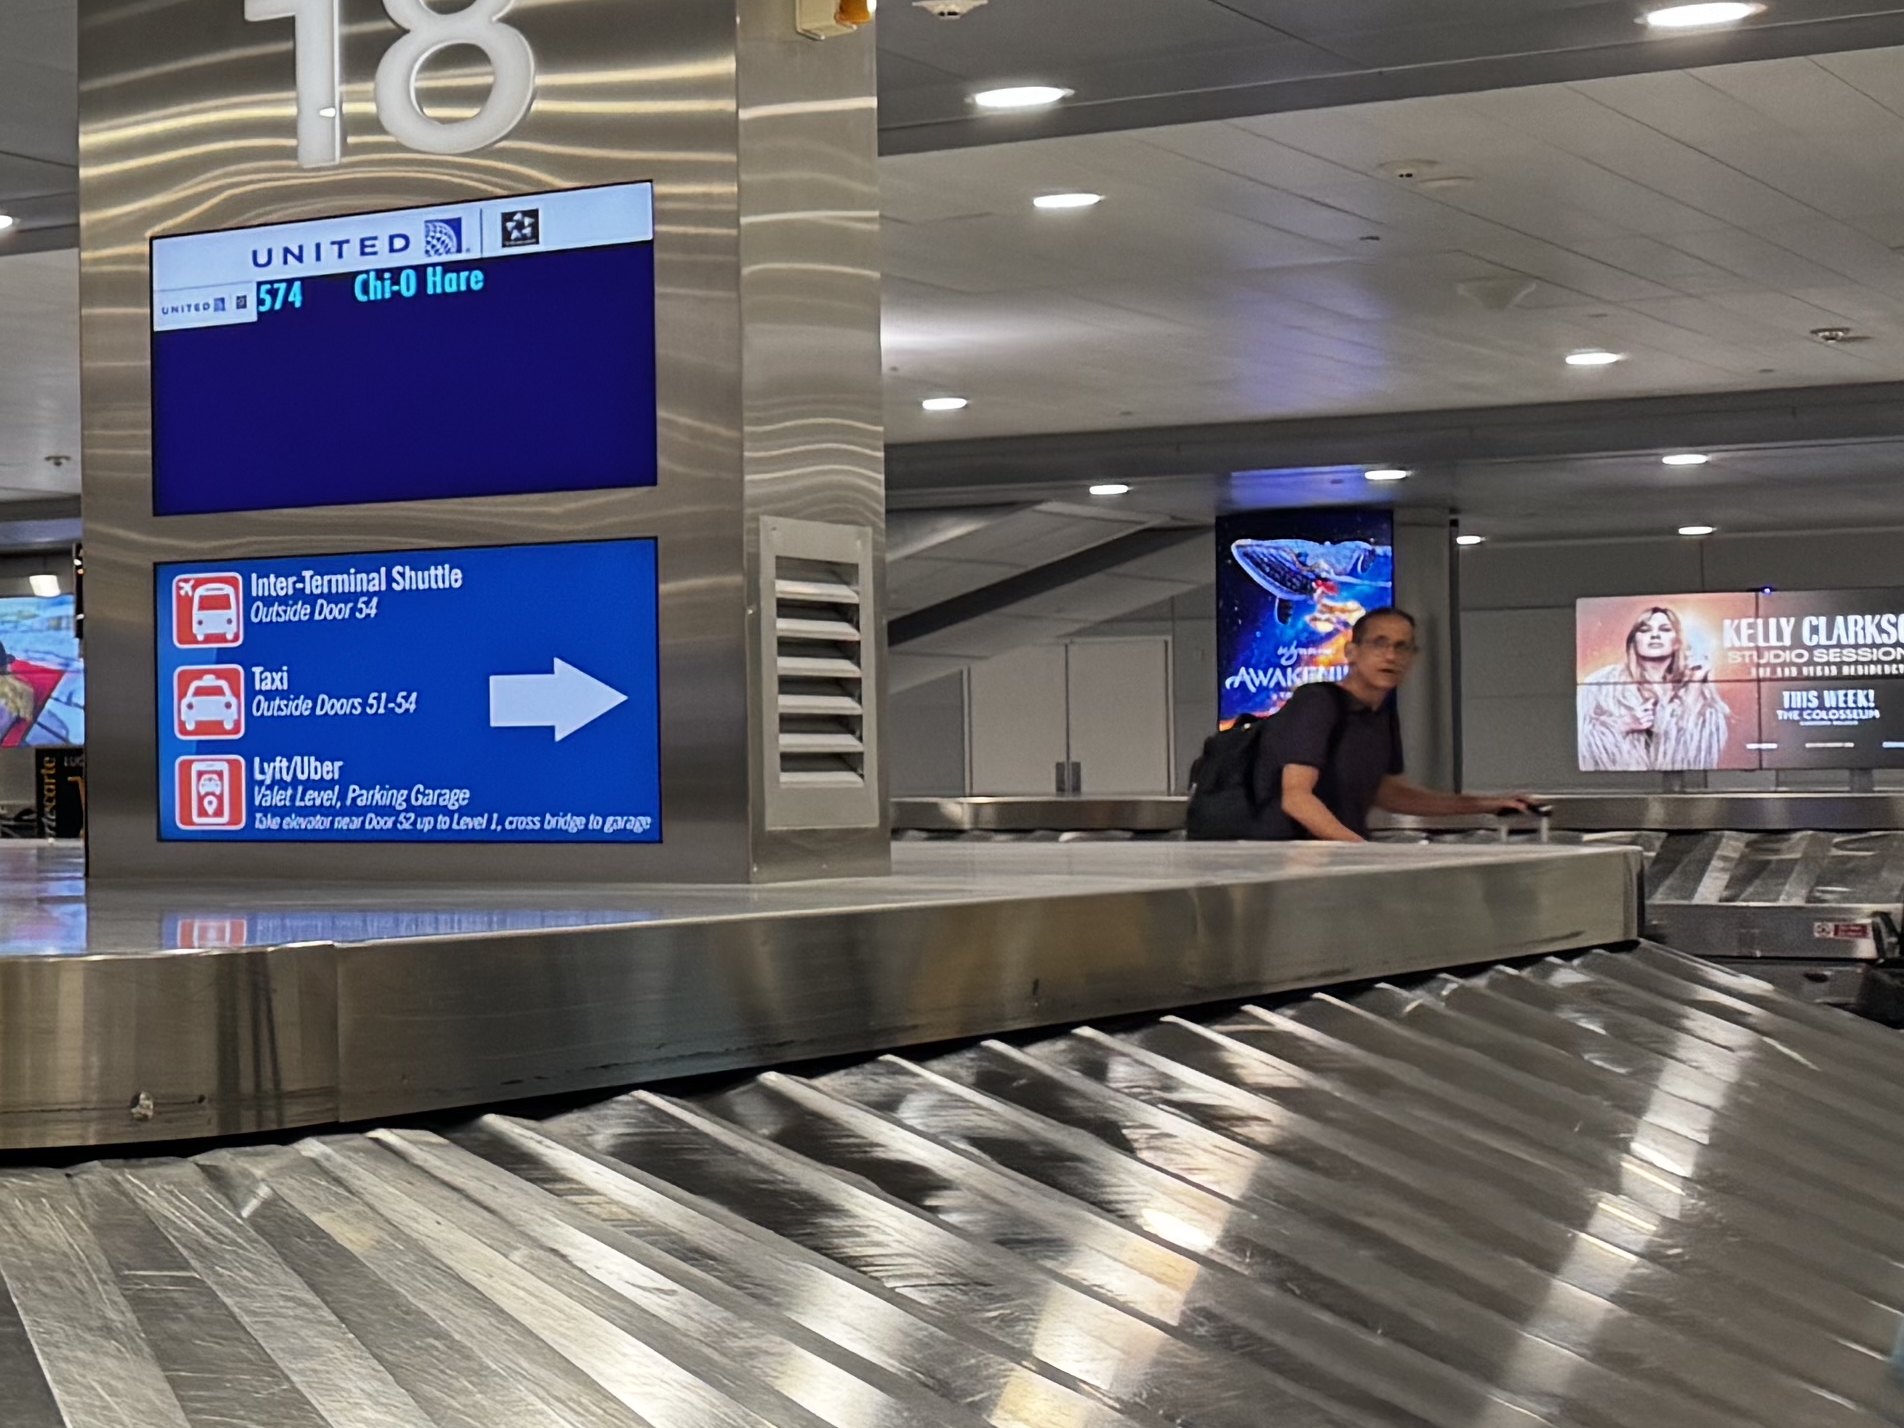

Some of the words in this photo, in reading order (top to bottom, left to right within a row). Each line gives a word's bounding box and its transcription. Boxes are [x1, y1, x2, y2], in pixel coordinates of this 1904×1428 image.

[251, 233, 411, 268] UNITED
[257, 281, 302, 312] 574
[353, 268, 418, 303] Chi-O
[426, 267, 484, 295] Hare
[161, 302, 210, 315] UNITED
[251, 567, 386, 597] Inter-Terminal
[391, 563, 463, 591] Shuttle
[250, 599, 311, 624] Outside
[313, 598, 354, 621] Door
[355, 595, 379, 619] 54
[1722, 616, 1795, 648] KELLY
[1728, 649, 1809, 664] STUDIO
[251, 665, 288, 691] Taxi
[252, 693, 312, 717] Outside
[315, 692, 362, 716] Doors
[365, 690, 418, 714] 51-54
[253, 756, 344, 785] Lyft/Uber
[254, 785, 292, 807] Valet
[295, 784, 342, 809] Level,
[345, 784, 408, 810] Parking
[410, 783, 471, 810] Garage
[255, 813, 280, 830] Take
[282, 813, 332, 830] elevator
[334, 814, 362, 830] near
[365, 813, 395, 830] Door
[396, 812, 416, 830] 52
[417, 815, 435, 833] up
[436, 814, 450, 830] to
[452, 812, 489, 830] Level
[505, 816, 541, 830] cross
[543, 812, 586, 833] bridge
[588, 813, 602, 830] to
[603, 815, 652, 834] garage
